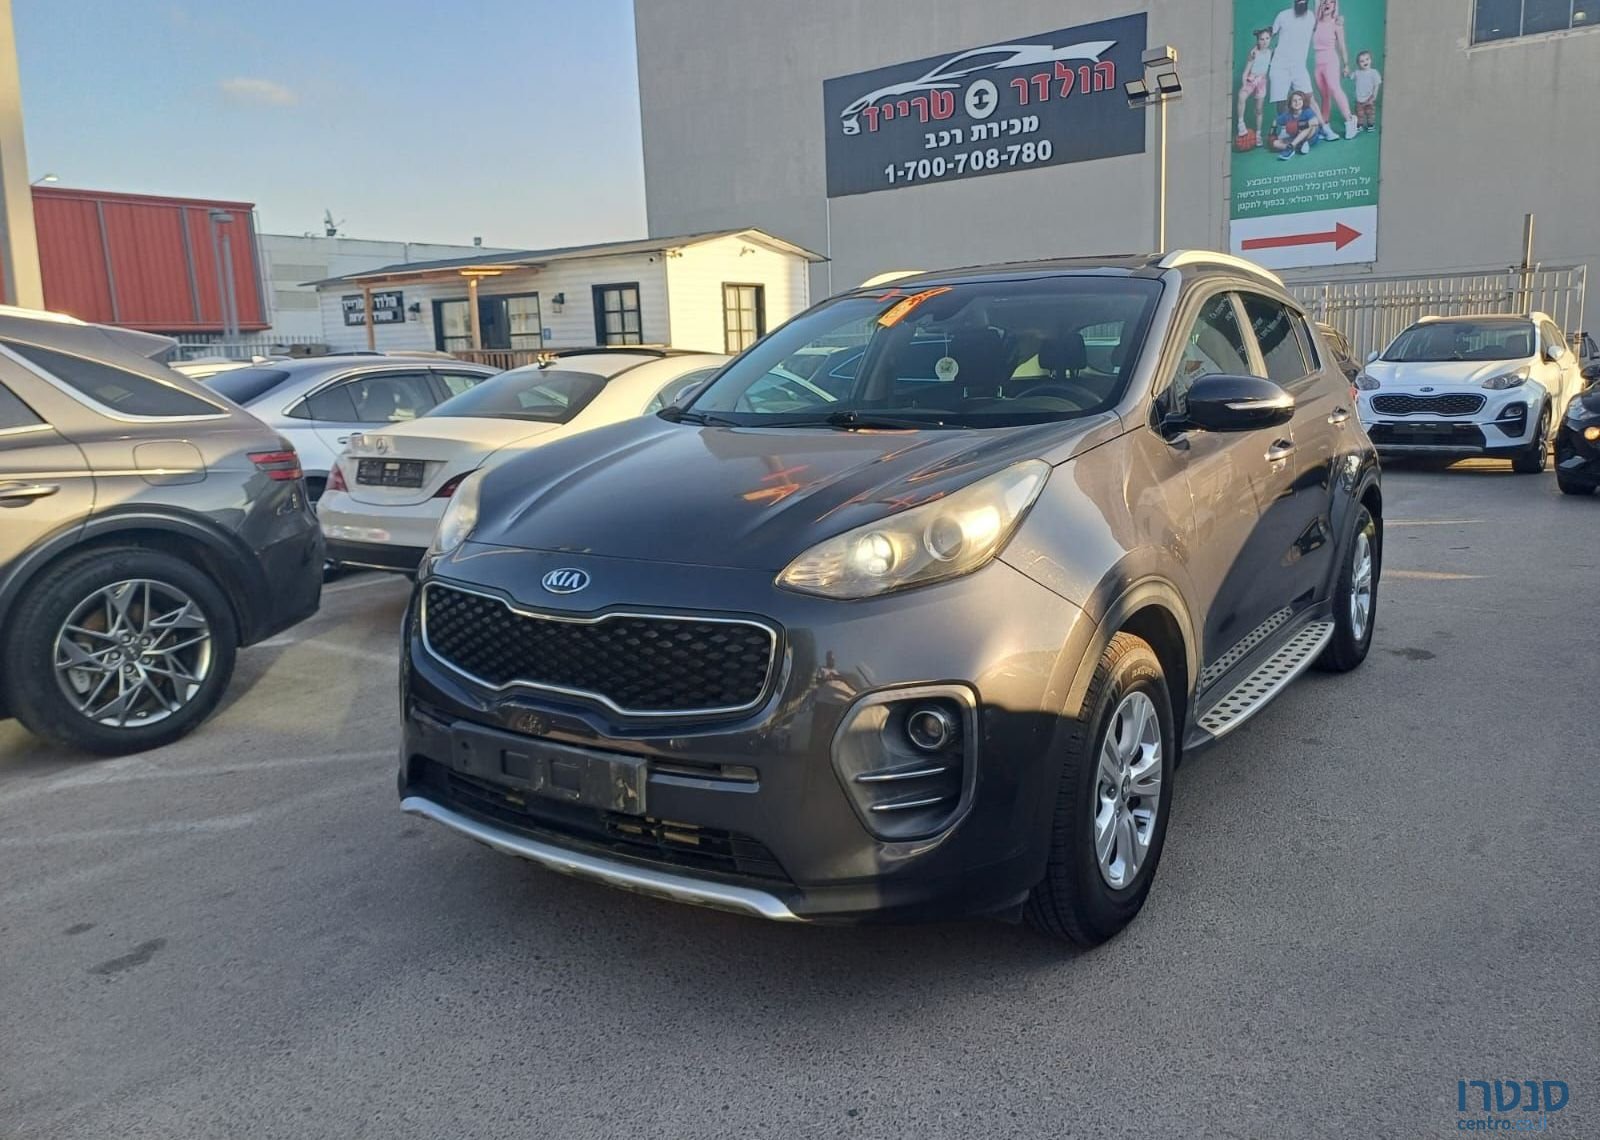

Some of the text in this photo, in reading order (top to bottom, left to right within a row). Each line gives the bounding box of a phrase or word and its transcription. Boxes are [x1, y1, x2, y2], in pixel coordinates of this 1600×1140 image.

[863, 60, 1116, 132] הולדר טרייד
[925, 115, 1039, 149] מכירת רכב
[885, 140, 1052, 183] 1-700-708-780
[1349, 166, 1361, 174] על
[1305, 182, 1321, 190] כלל
[1359, 176, 1371, 185] על
[1330, 191, 1342, 201] עד
[547, 570, 581, 588] KIA
